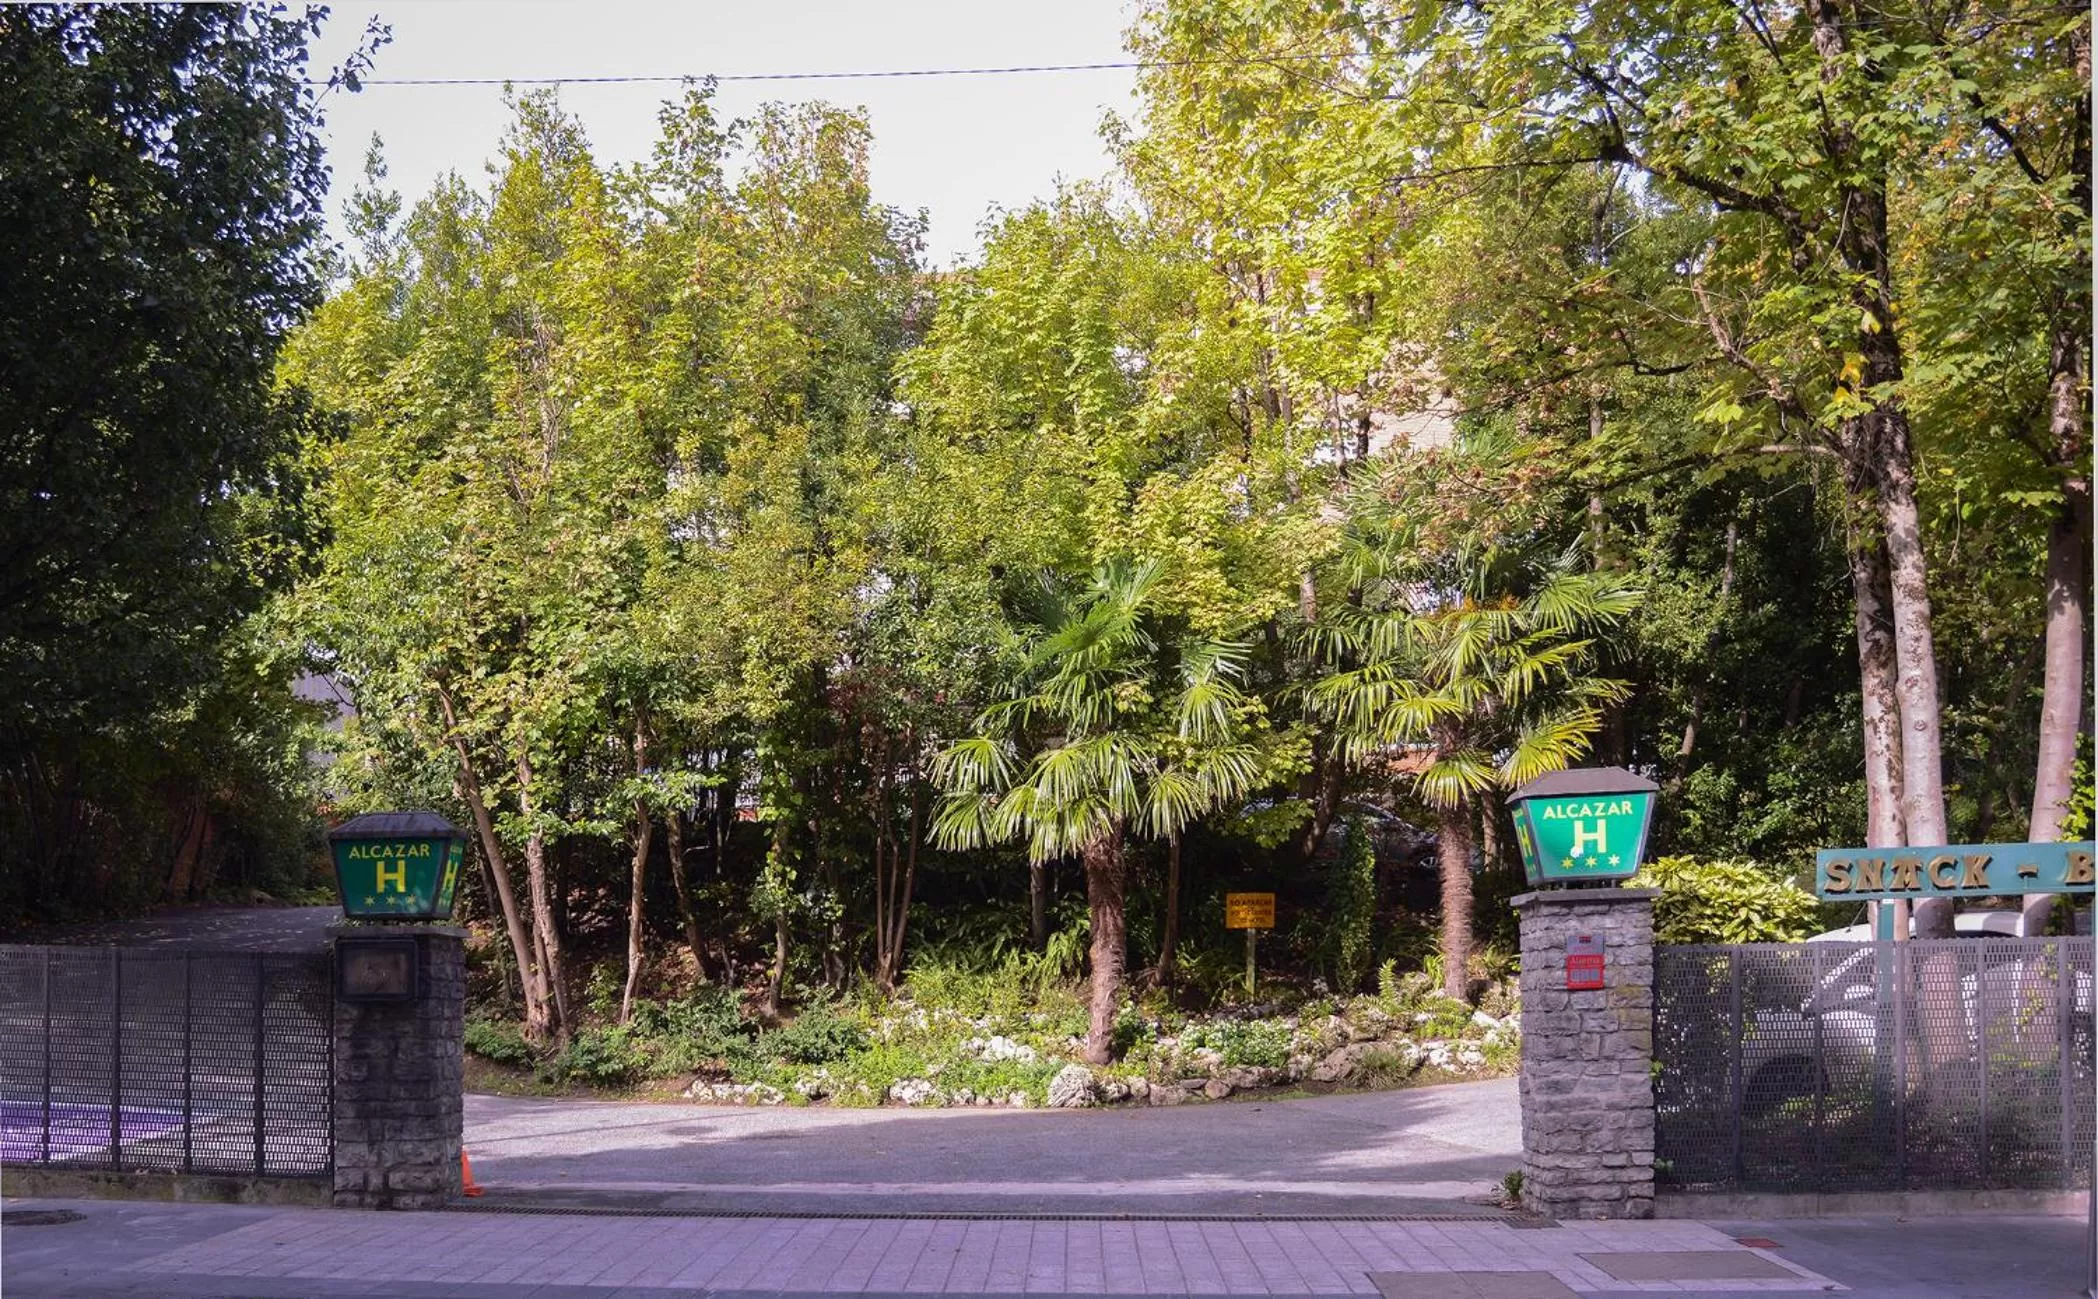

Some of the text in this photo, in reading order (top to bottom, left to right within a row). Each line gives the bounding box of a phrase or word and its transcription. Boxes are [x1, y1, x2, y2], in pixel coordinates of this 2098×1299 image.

[1542, 801, 1633, 820] ALCAZAR
[348, 843, 431, 859] ALCAZAR
[1573, 818, 1607, 853] H
[376, 859, 406, 893] H
[441, 859, 459, 894] H
[1824, 854, 1992, 893] SNACK
